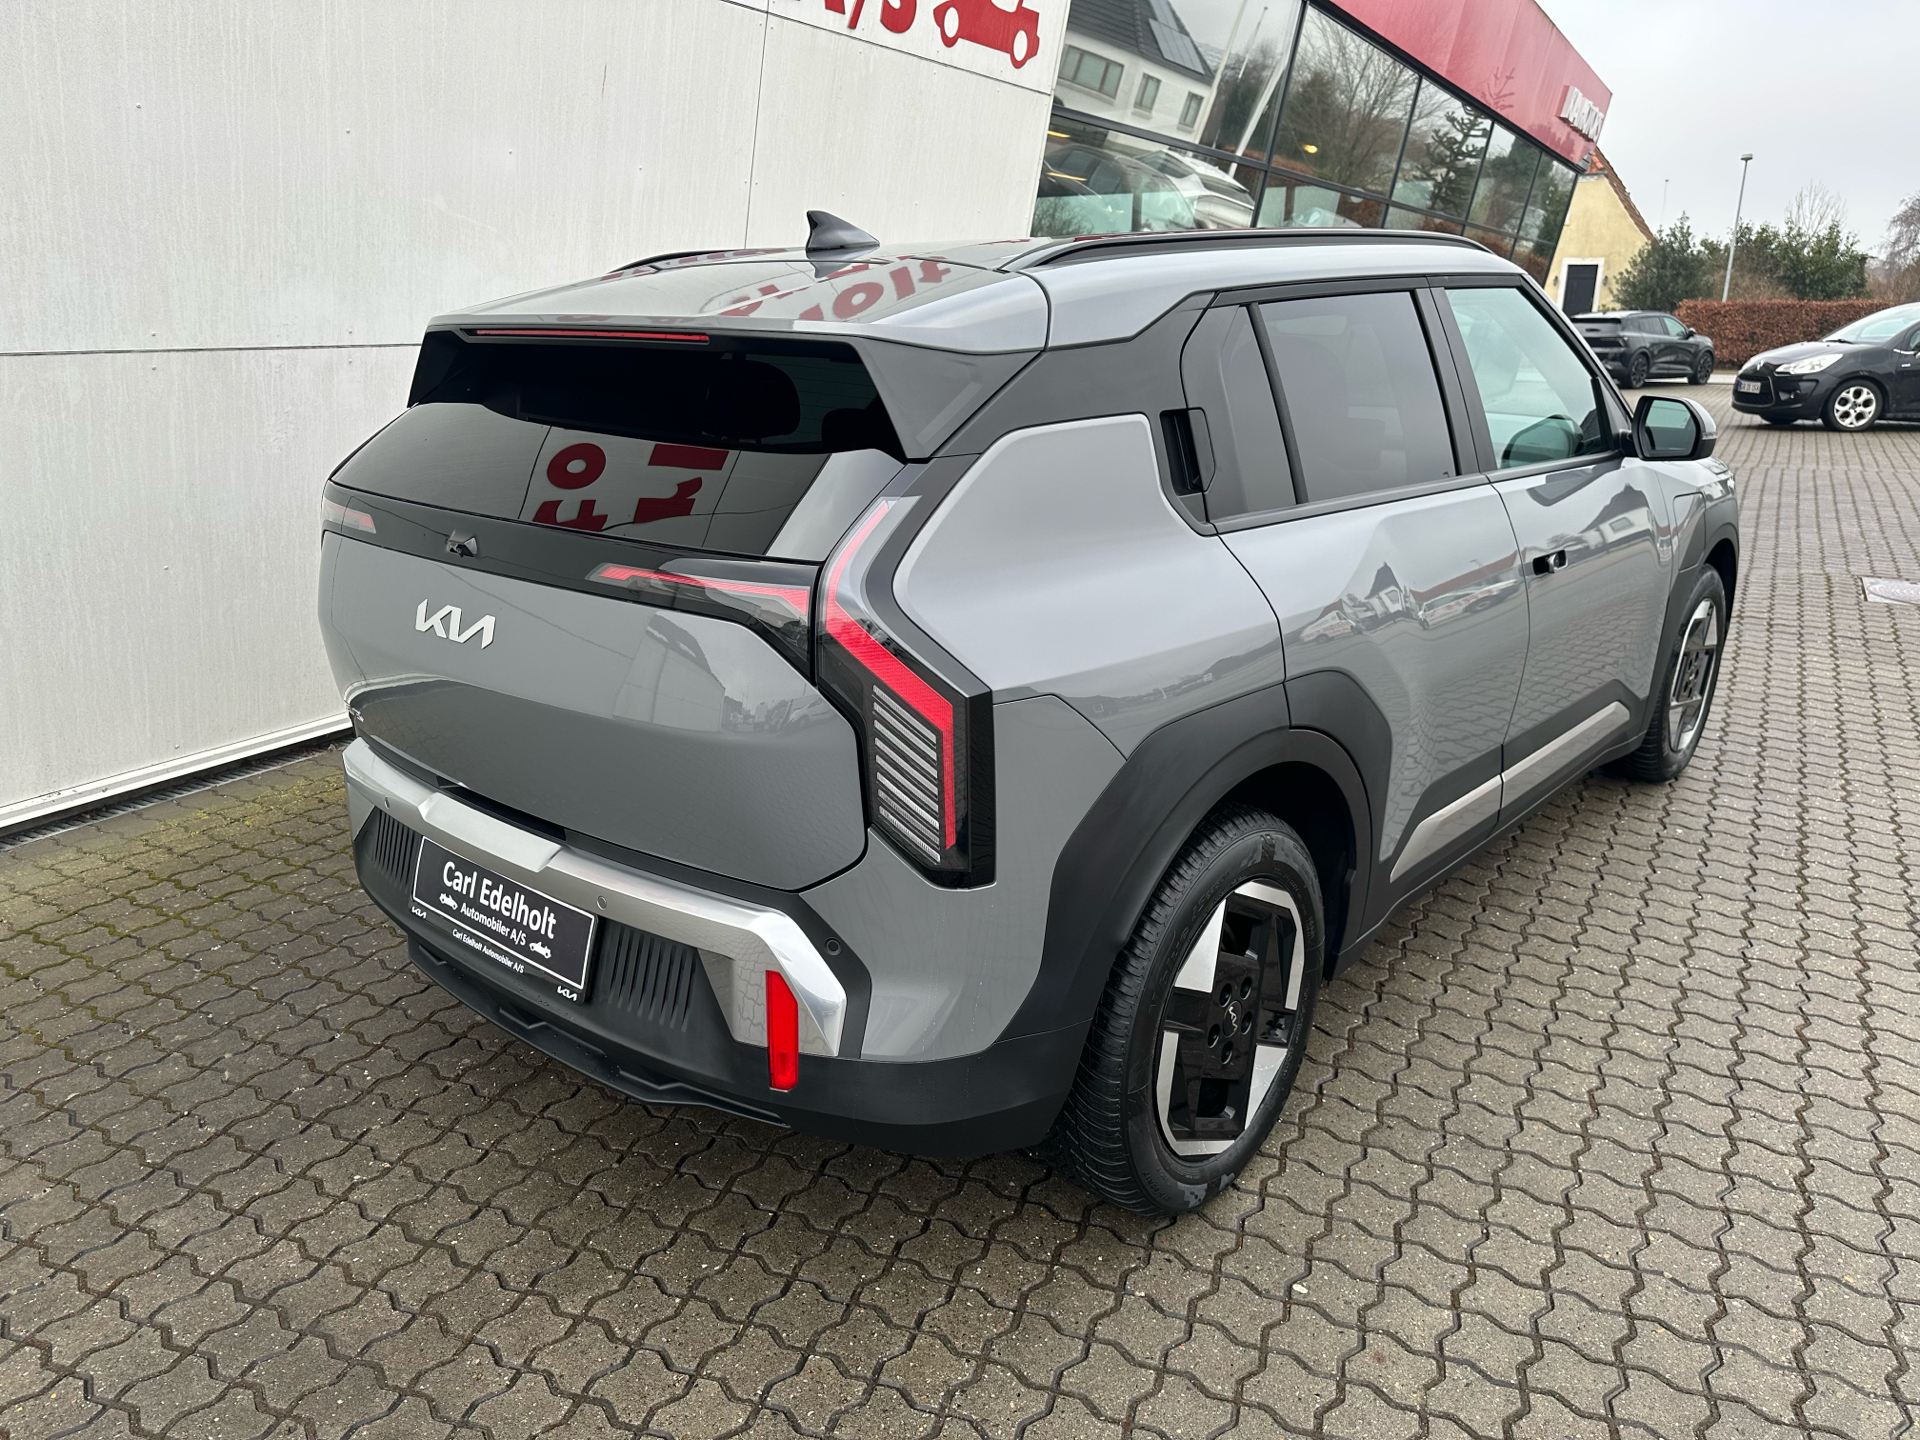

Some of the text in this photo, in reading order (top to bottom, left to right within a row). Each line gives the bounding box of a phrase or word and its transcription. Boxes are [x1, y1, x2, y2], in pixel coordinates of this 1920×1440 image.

[443, 861, 557, 940] Carl Edelholt
[460, 902, 527, 947] Automobiler A/S
[452, 928, 525, 974] Carl Edelholt Automobiler A/S
